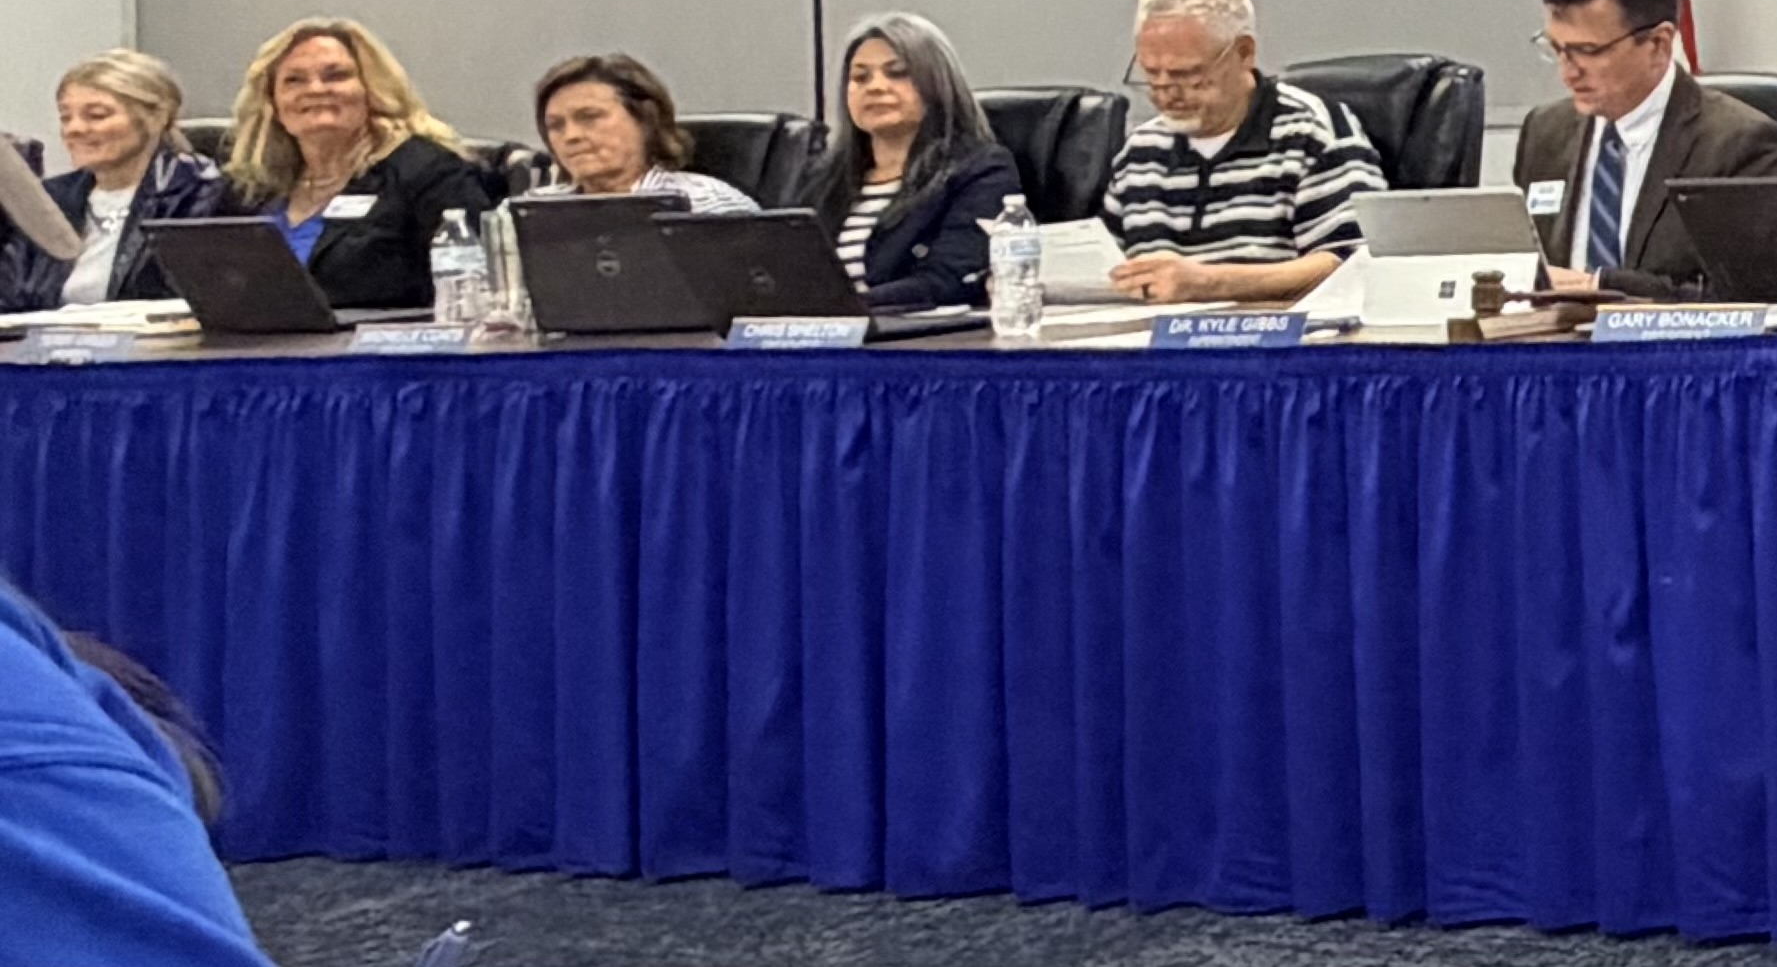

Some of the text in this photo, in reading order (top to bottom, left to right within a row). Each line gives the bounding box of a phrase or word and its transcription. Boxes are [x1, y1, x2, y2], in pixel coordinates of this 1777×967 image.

[1198, 317, 1239, 332] KYLE
[1241, 316, 1290, 331] GIBBS
[1608, 311, 1754, 328] GARY BONACKER
